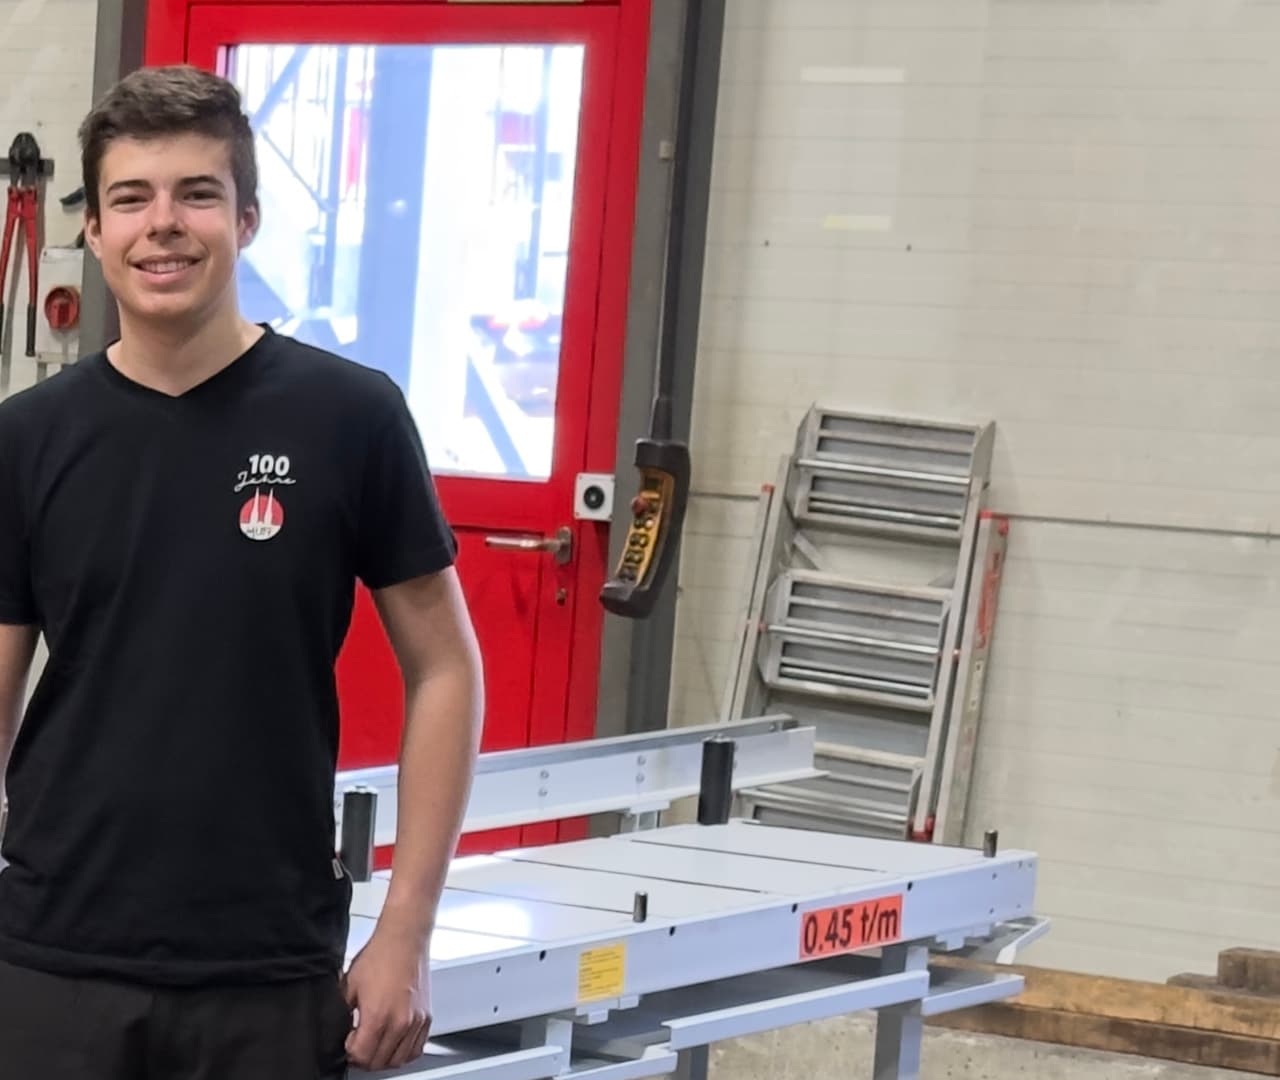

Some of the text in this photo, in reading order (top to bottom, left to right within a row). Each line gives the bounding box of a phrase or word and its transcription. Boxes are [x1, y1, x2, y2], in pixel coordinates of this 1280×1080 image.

[248, 454, 290, 476] 100
[804, 902, 898, 954] 0.45 t/m
